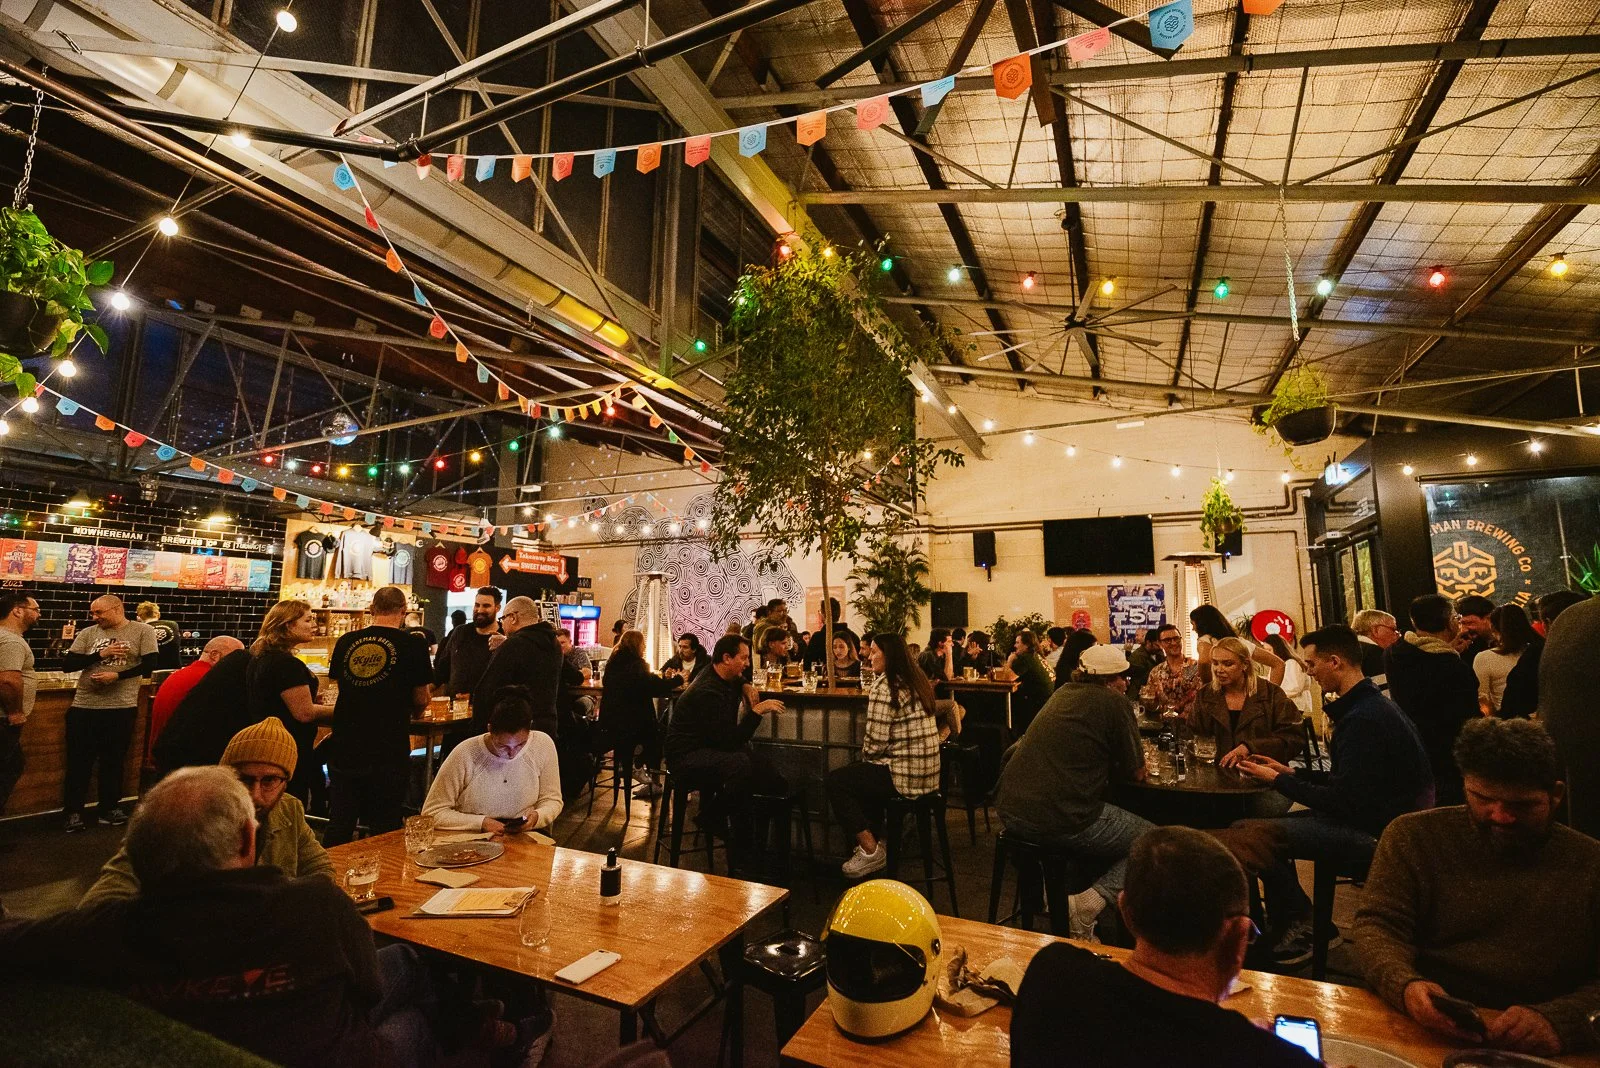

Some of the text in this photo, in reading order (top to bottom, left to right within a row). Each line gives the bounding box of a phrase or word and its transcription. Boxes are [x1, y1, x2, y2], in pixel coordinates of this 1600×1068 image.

[72, 527, 143, 540] NOWHEREMAN
[1466, 519, 1525, 555] BREWING
[1517, 556, 1532, 572] CO
[519, 552, 546, 562] Takeaway
[520, 562, 559, 572] SWEET MERCH
[1130, 608, 1146, 624] 5
